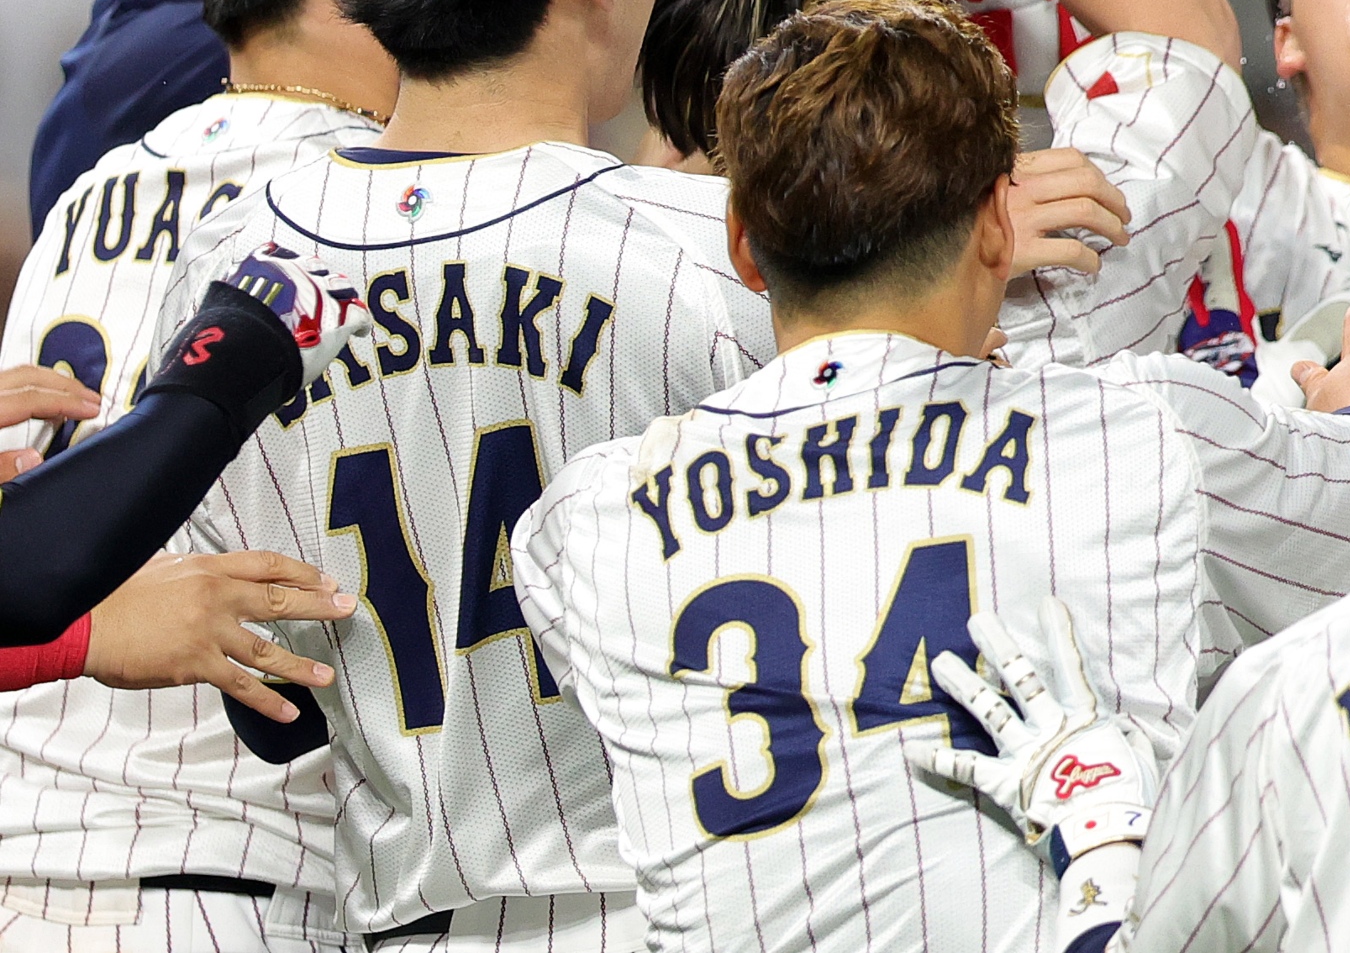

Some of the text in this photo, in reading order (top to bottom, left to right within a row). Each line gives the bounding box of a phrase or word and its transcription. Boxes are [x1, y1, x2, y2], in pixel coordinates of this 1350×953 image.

[269, 260, 615, 432] SAKI
[631, 399, 1039, 562] YOSHIDA
[325, 419, 563, 737] 14
[665, 533, 1000, 843] 34
[1125, 811, 1142, 826] 7
